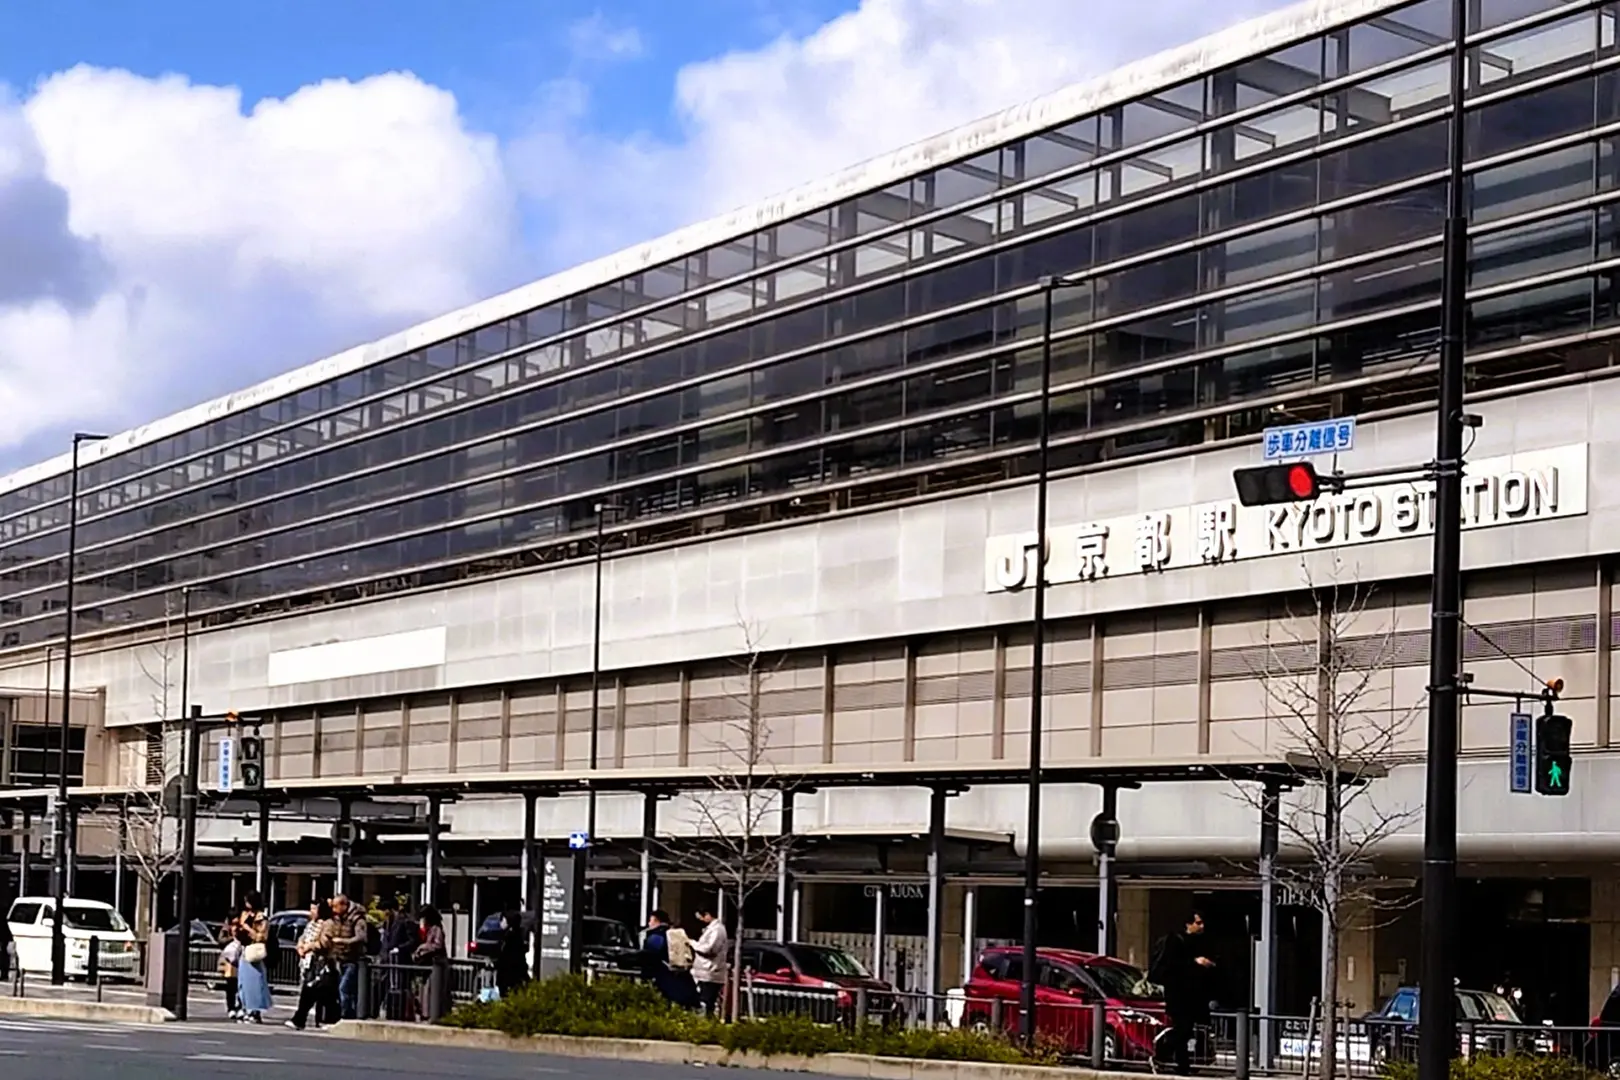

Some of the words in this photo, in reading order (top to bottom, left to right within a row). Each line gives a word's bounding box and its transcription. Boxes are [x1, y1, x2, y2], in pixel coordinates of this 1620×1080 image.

[1267, 424, 1351, 456] 歩車分離信号
[1076, 502, 1238, 582] 京都駅
[1264, 491, 1382, 551] KYOTO
[1391, 464, 1559, 534] STTION
